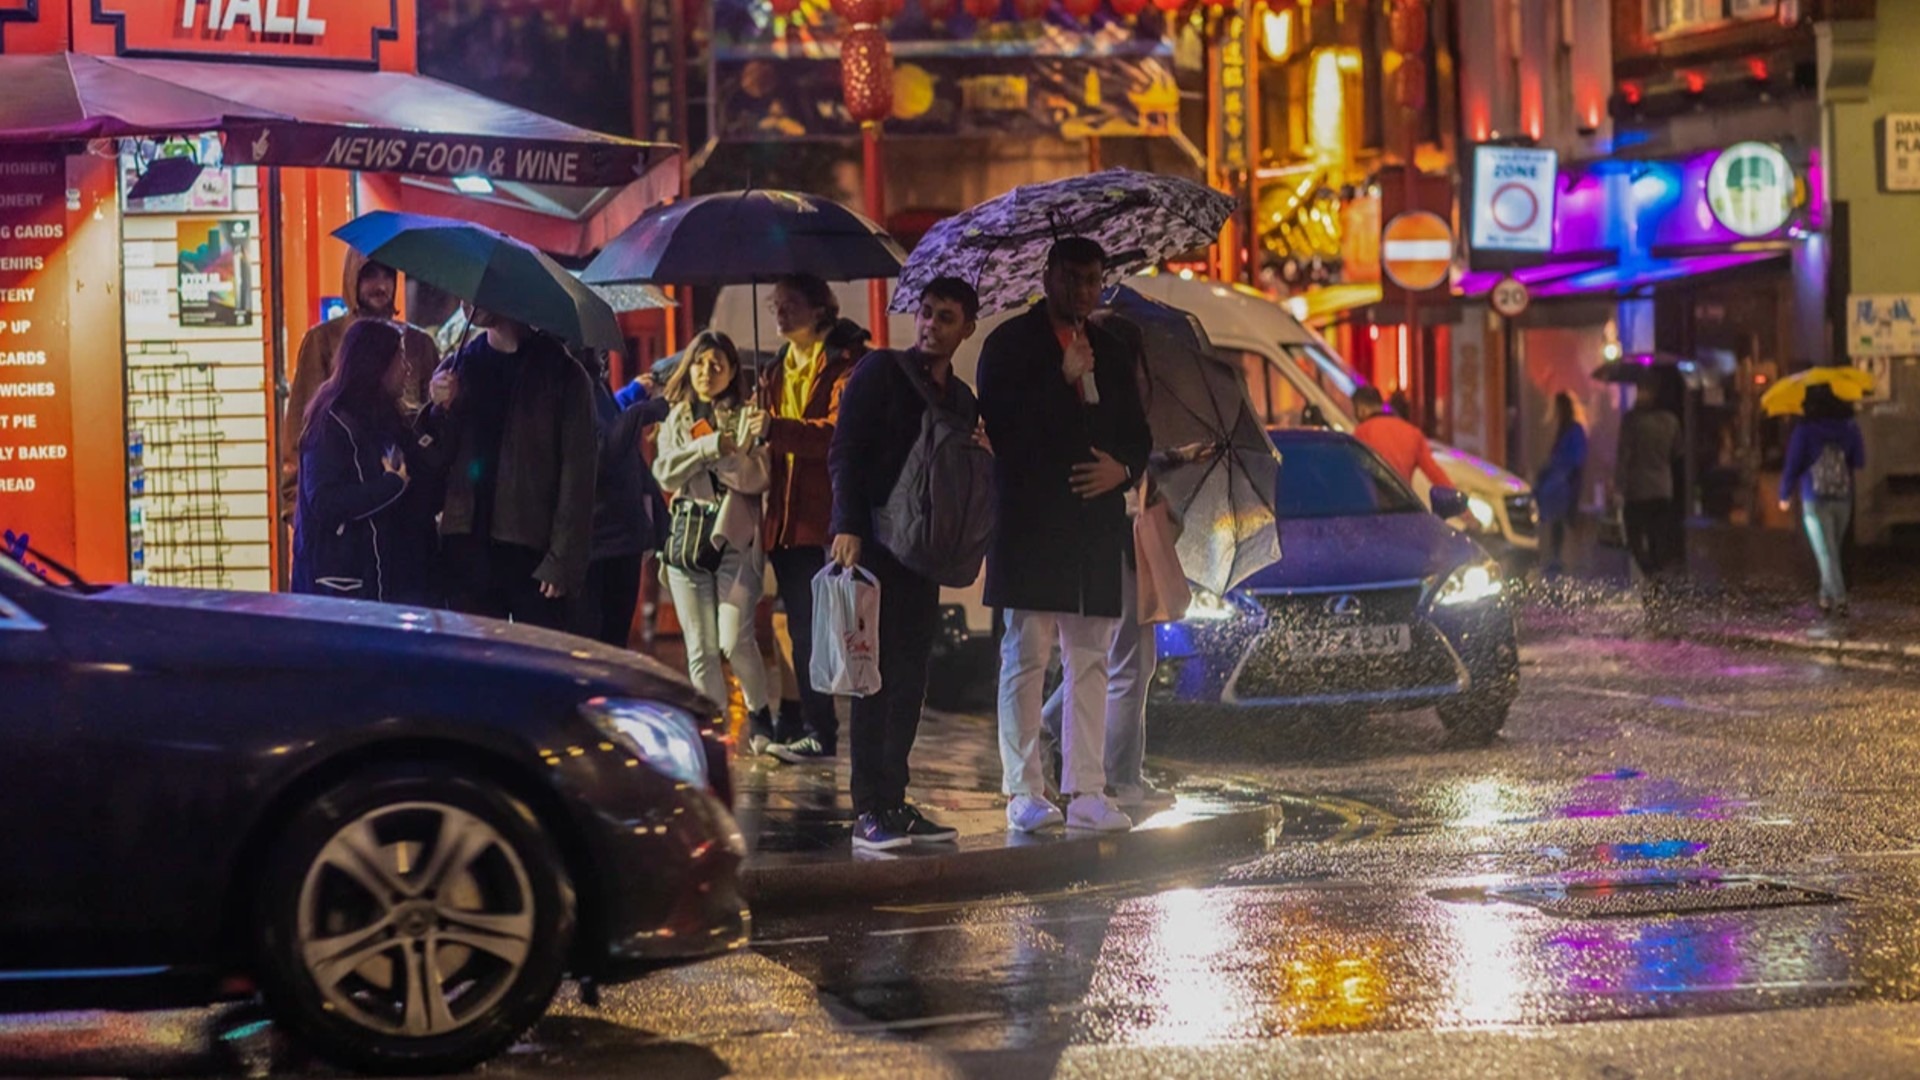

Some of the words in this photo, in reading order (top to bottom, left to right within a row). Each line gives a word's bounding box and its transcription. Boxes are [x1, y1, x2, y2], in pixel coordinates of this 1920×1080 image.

[182, 0, 327, 36] HALL
[324, 136, 407, 169] NEWS
[408, 141, 484, 174] FOOD
[487, 147, 505, 176] &
[515, 149, 579, 182] WINE
[14, 224, 63, 239] CARDS
[0, 287, 35, 302] TERY
[1500, 288, 1524, 305] 20
[11, 320, 32, 334] UP
[0, 351, 47, 366] CARDS
[12, 414, 37, 429] PIE
[18, 445, 67, 460] BAKED
